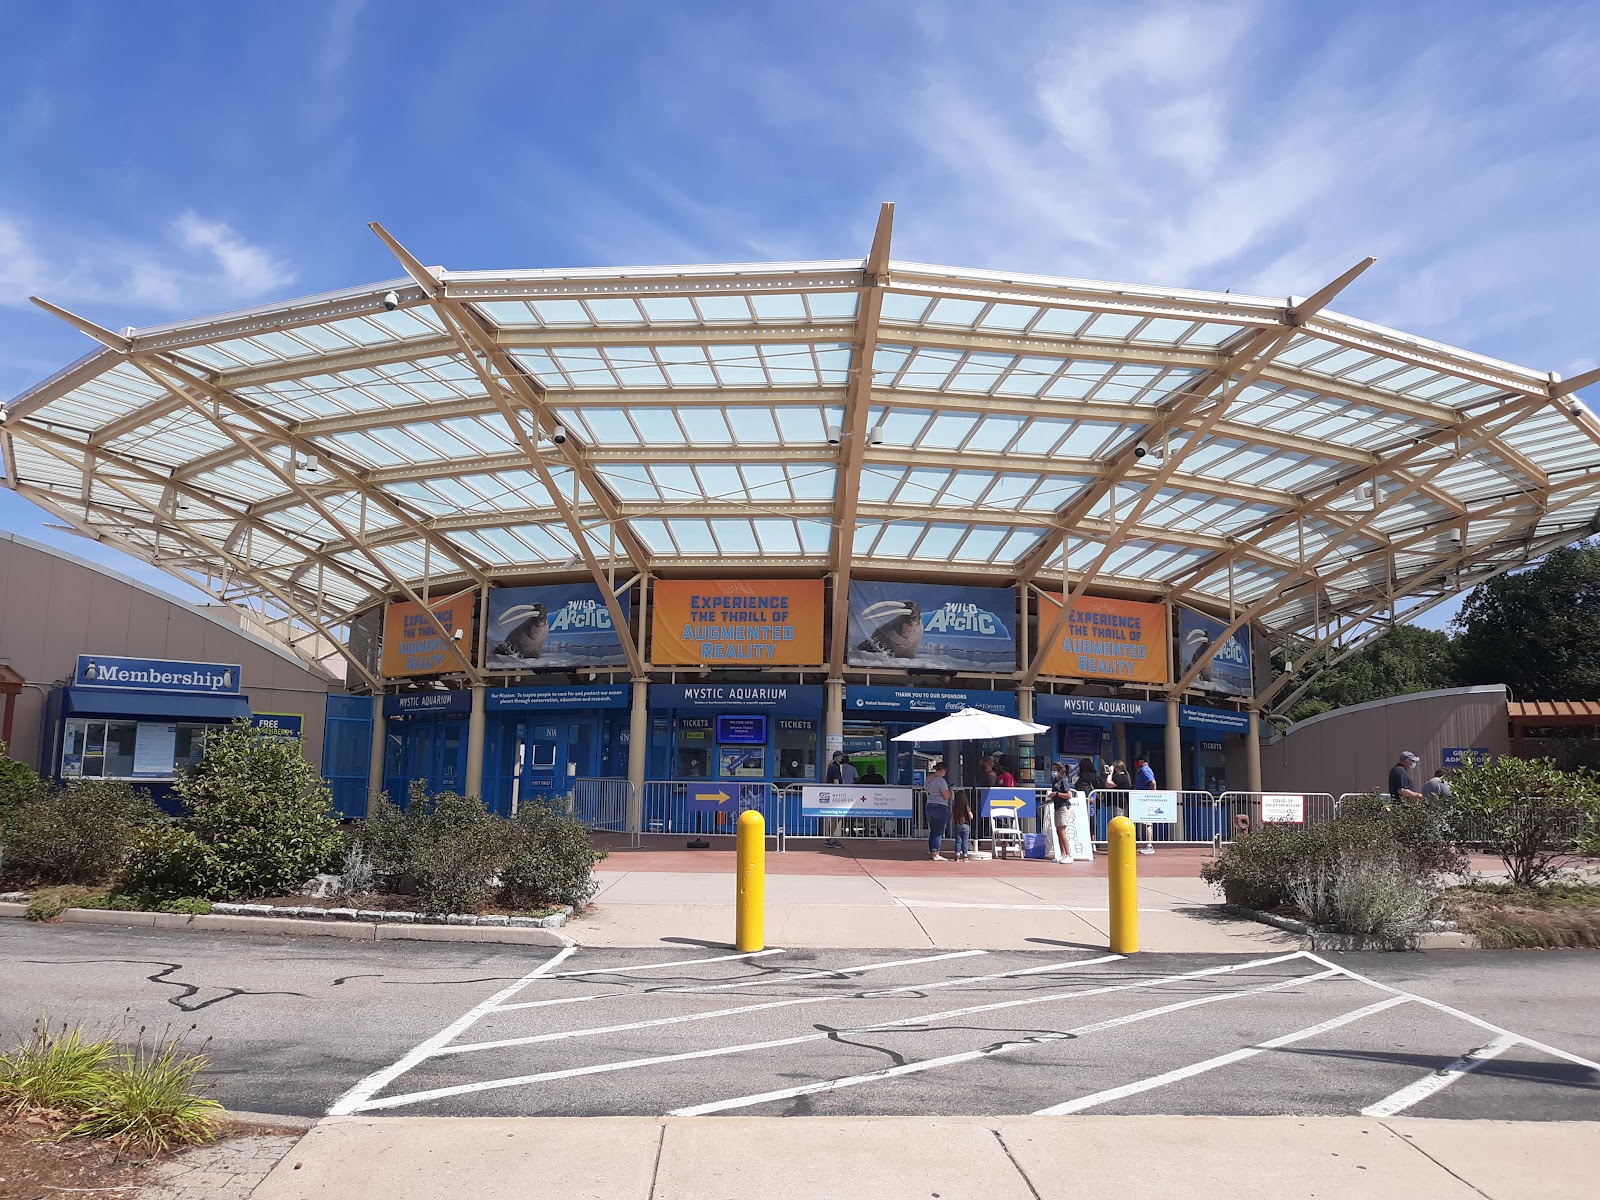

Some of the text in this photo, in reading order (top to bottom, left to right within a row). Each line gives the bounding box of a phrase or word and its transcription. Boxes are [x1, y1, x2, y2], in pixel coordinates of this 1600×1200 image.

[568, 600, 596, 611] WILD
[691, 596, 789, 609] EXPERIENCE
[945, 602, 978, 613] WILD
[550, 608, 611, 631] ARCTIC
[691, 612, 789, 622] THE THRILL OF
[924, 610, 996, 634] ARCTIC
[1069, 610, 1141, 629] EXPERIENCE
[404, 629, 416, 638] THE
[682, 624, 795, 641] AUGMENTED
[1069, 625, 1142, 641] THE THRILL OF
[701, 642, 776, 659] REALITY
[1063, 637, 1146, 659] AUGMENTED
[406, 654, 445, 670] REALITY
[1078, 656, 1134, 675] REALITY
[98, 666, 224, 690] Membership
[399, 695, 452, 707] MYSTIC AQUARIUM
[685, 688, 787, 700] MYSTIC AQUARIUM
[1064, 700, 1142, 714] MYSTIC AQUARIUM
[259, 720, 279, 728] FREE
[780, 721, 812, 729] TICKETS
